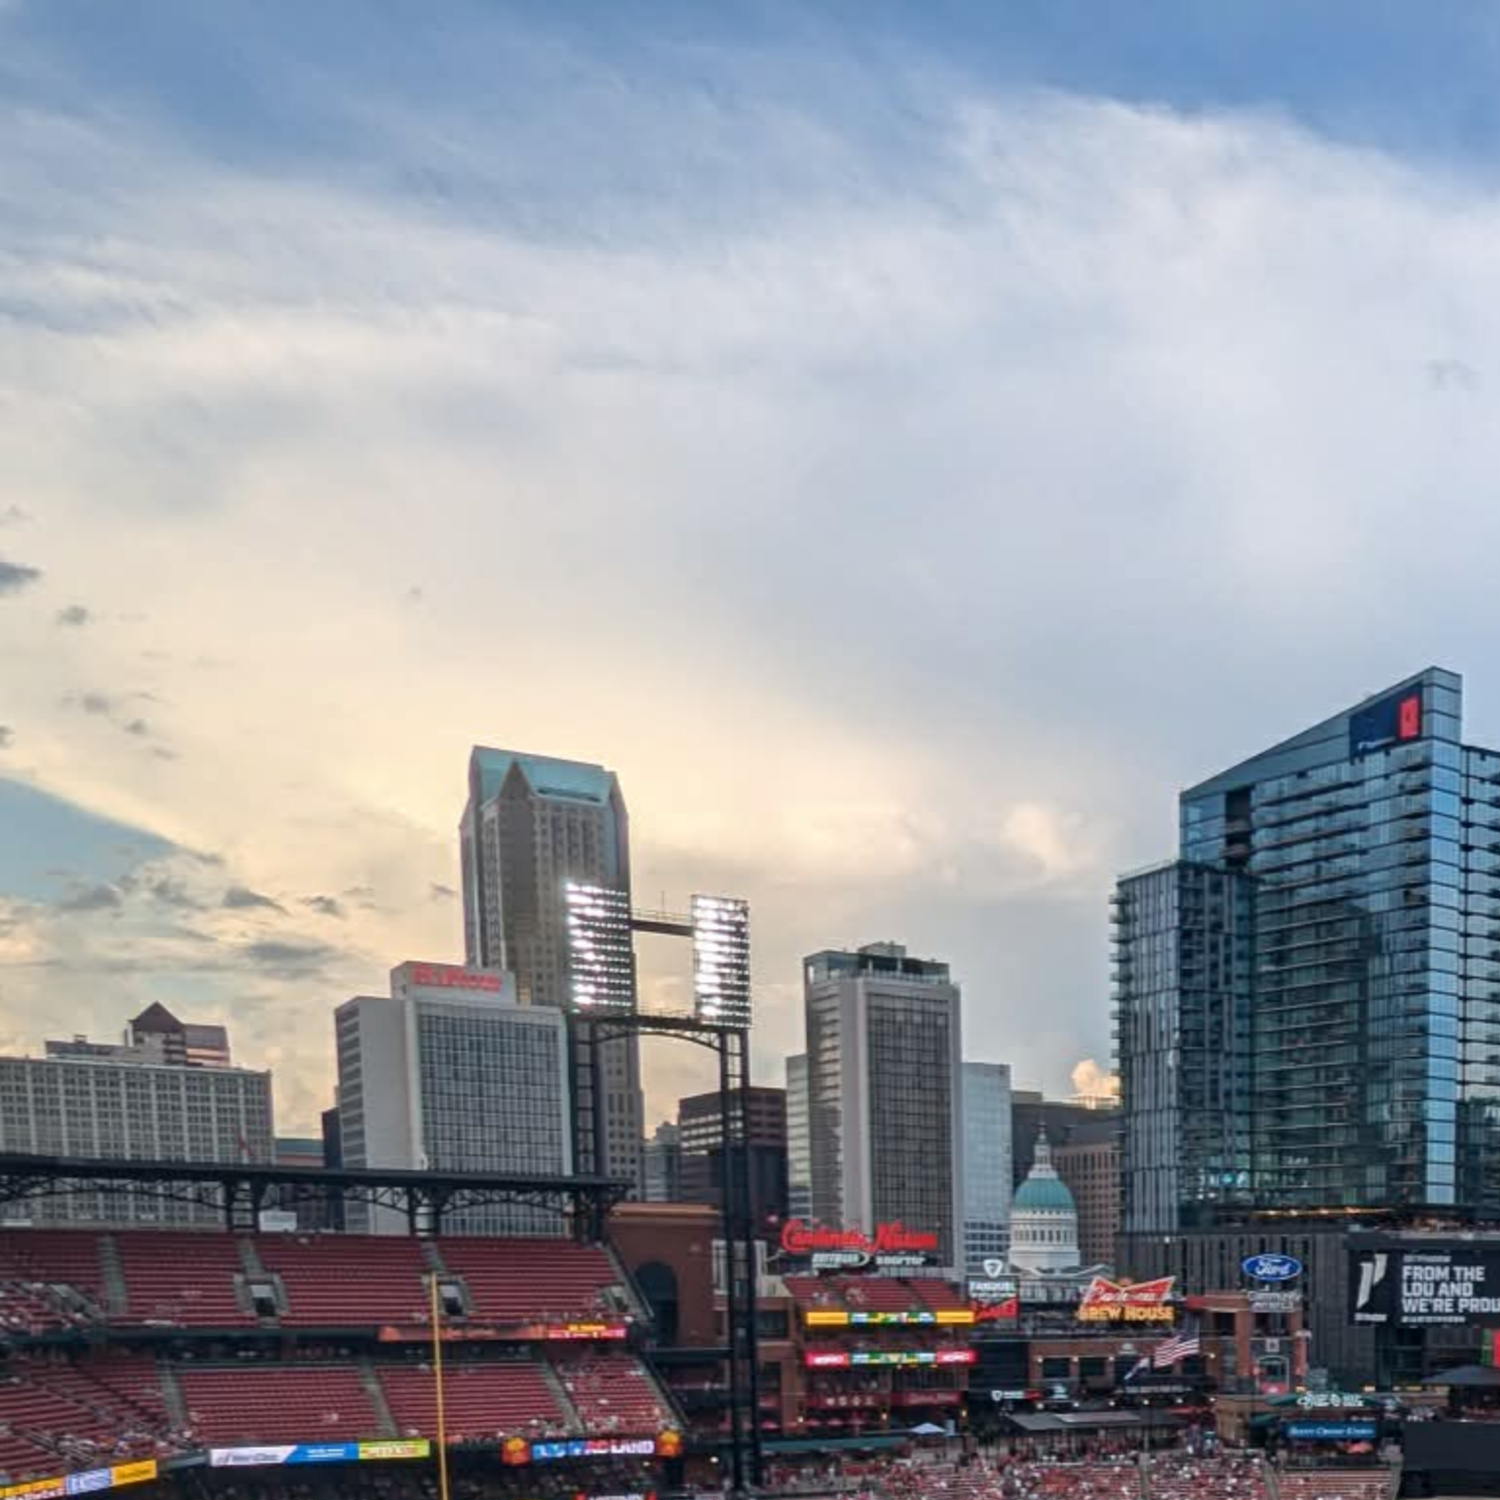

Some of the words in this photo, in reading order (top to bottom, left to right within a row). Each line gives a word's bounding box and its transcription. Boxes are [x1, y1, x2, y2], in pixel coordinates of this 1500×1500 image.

[1254, 1258, 1293, 1276] Ford
[1402, 1266, 1450, 1281] FROM
[1453, 1266, 1486, 1281] THE
[1402, 1283, 1435, 1297] LOU
[1438, 1283, 1474, 1297] AND
[1402, 1299, 1454, 1313] WE'RE
[1079, 1307, 1121, 1320] BREW
[1124, 1307, 1174, 1320] HOUSE
